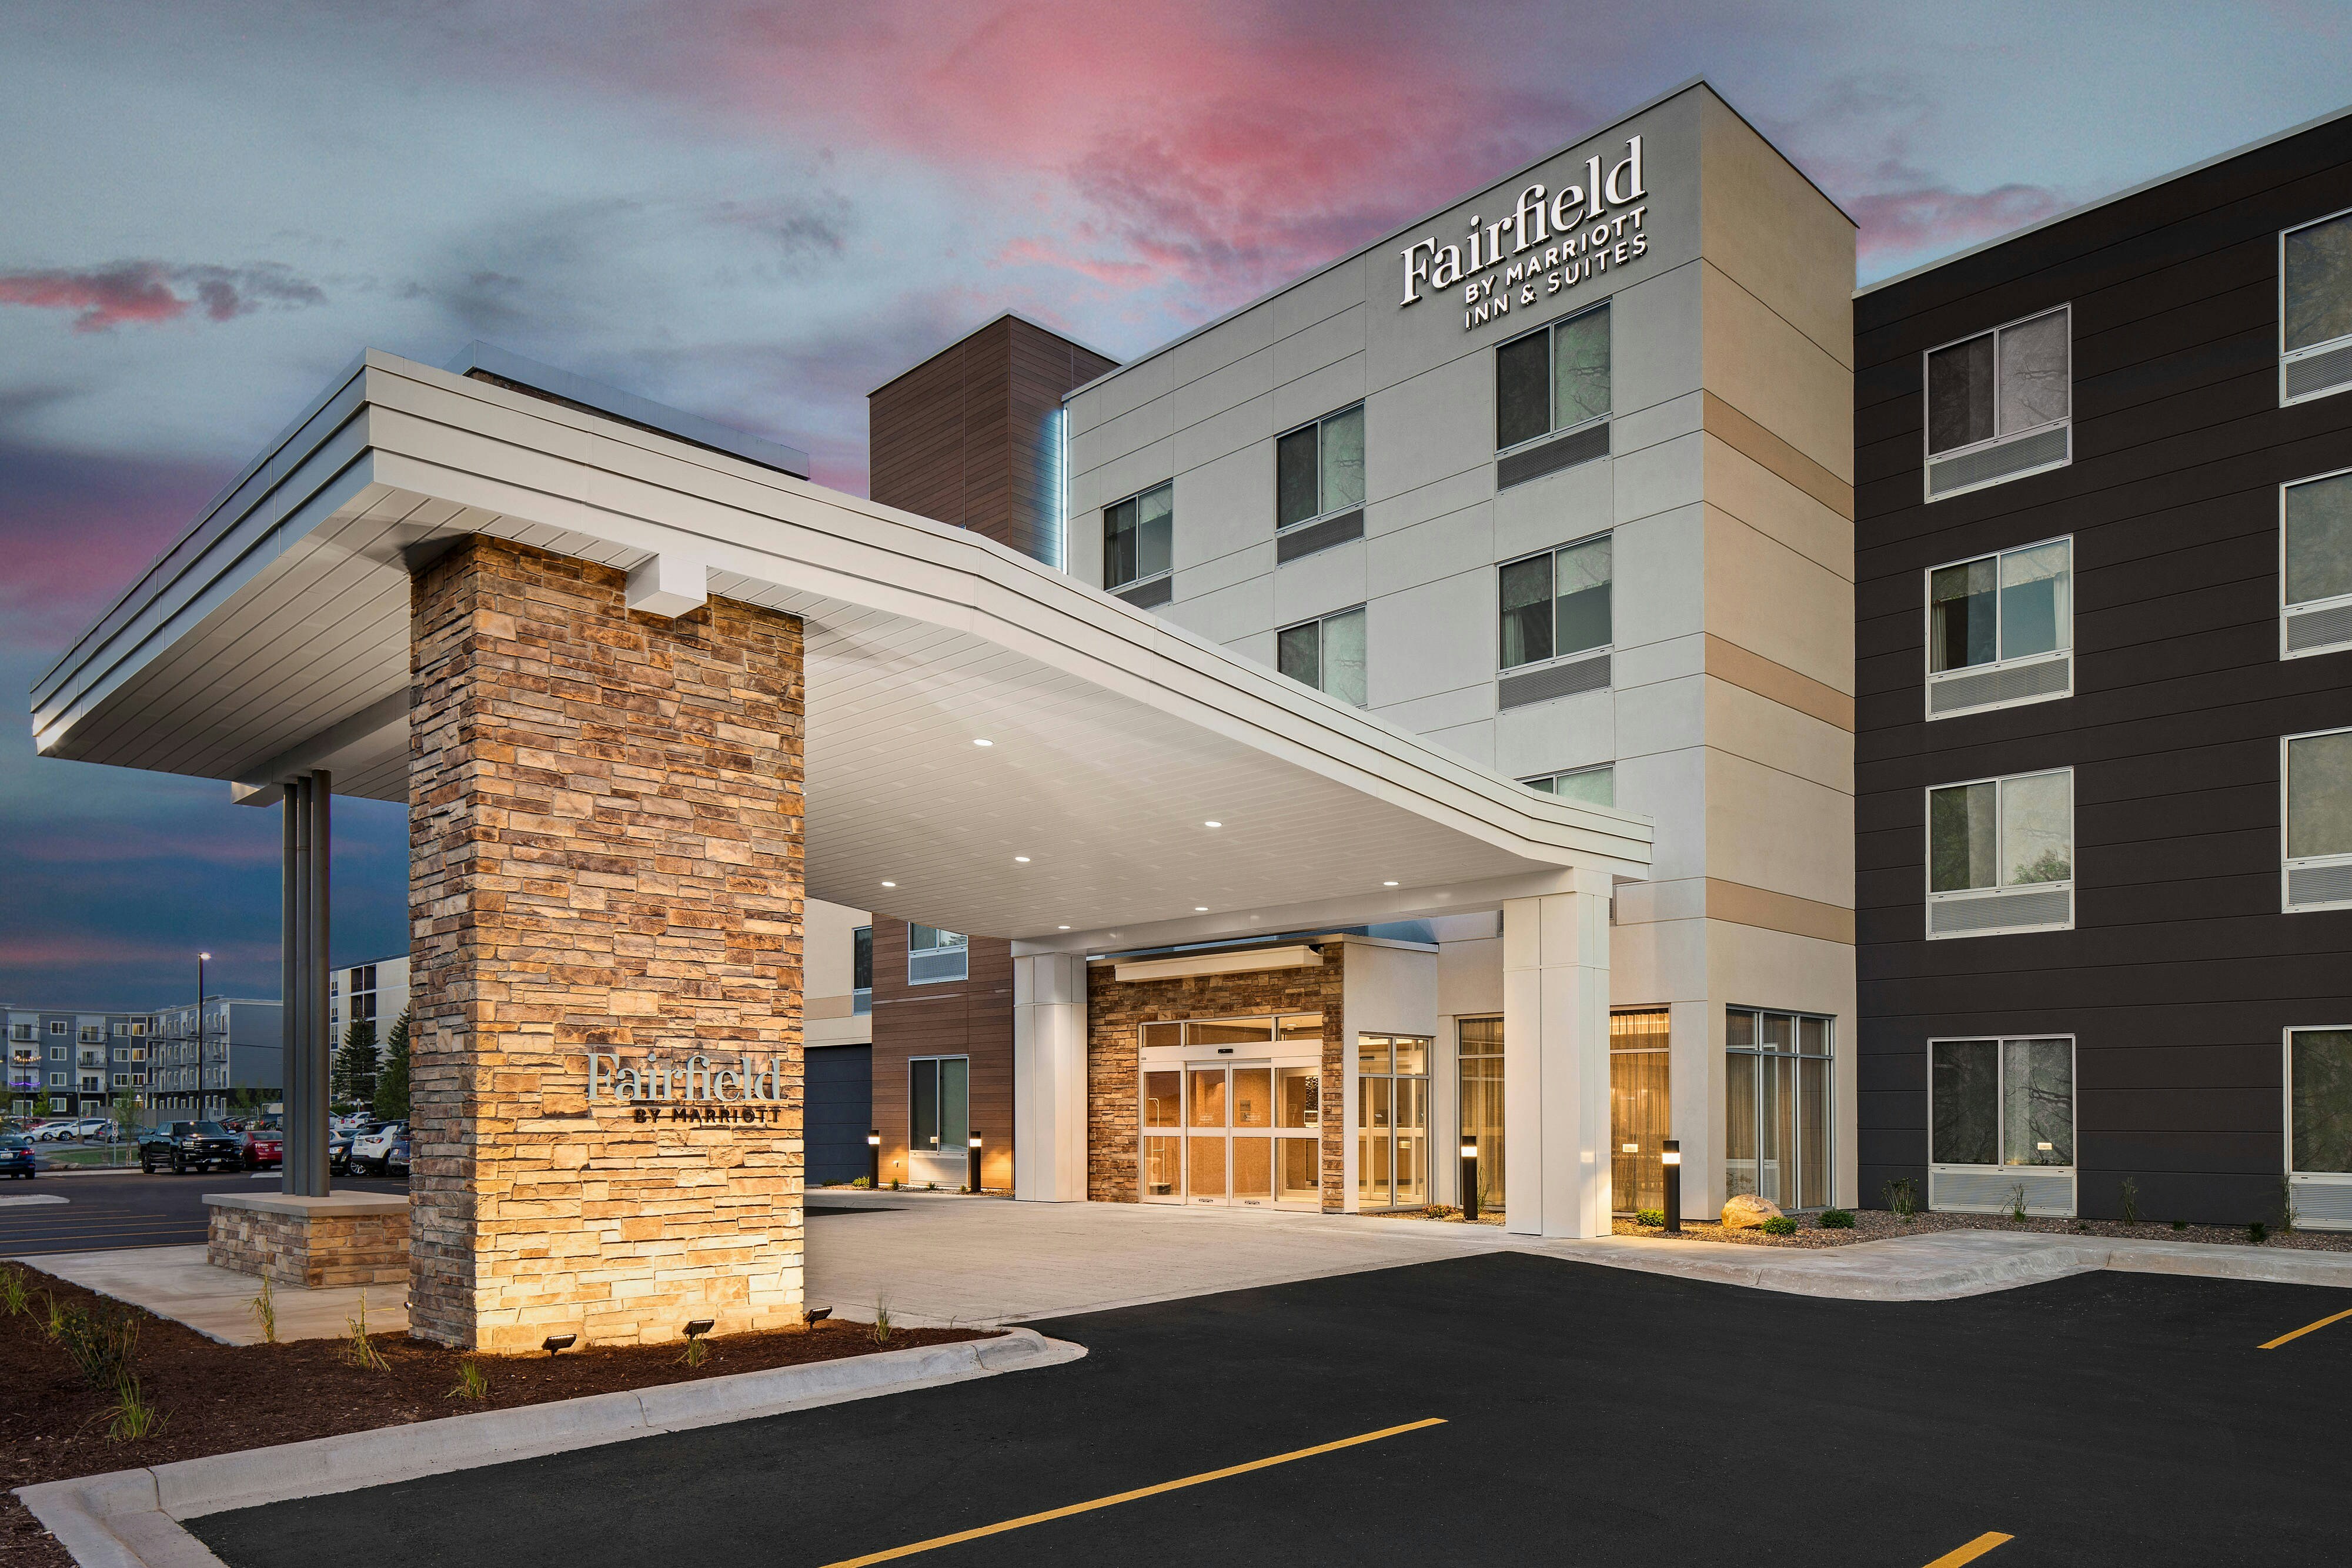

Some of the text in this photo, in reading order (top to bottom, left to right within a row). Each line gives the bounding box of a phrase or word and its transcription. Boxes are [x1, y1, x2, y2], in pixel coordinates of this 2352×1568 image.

[1400, 134, 1648, 306] Fairfield
[1465, 206, 1647, 305] BY MARRIOTT
[1465, 233, 1648, 330] INN & SUITES
[585, 1053, 783, 1102] Fairfield
[634, 1108, 781, 1124] BY MARRIOTT
